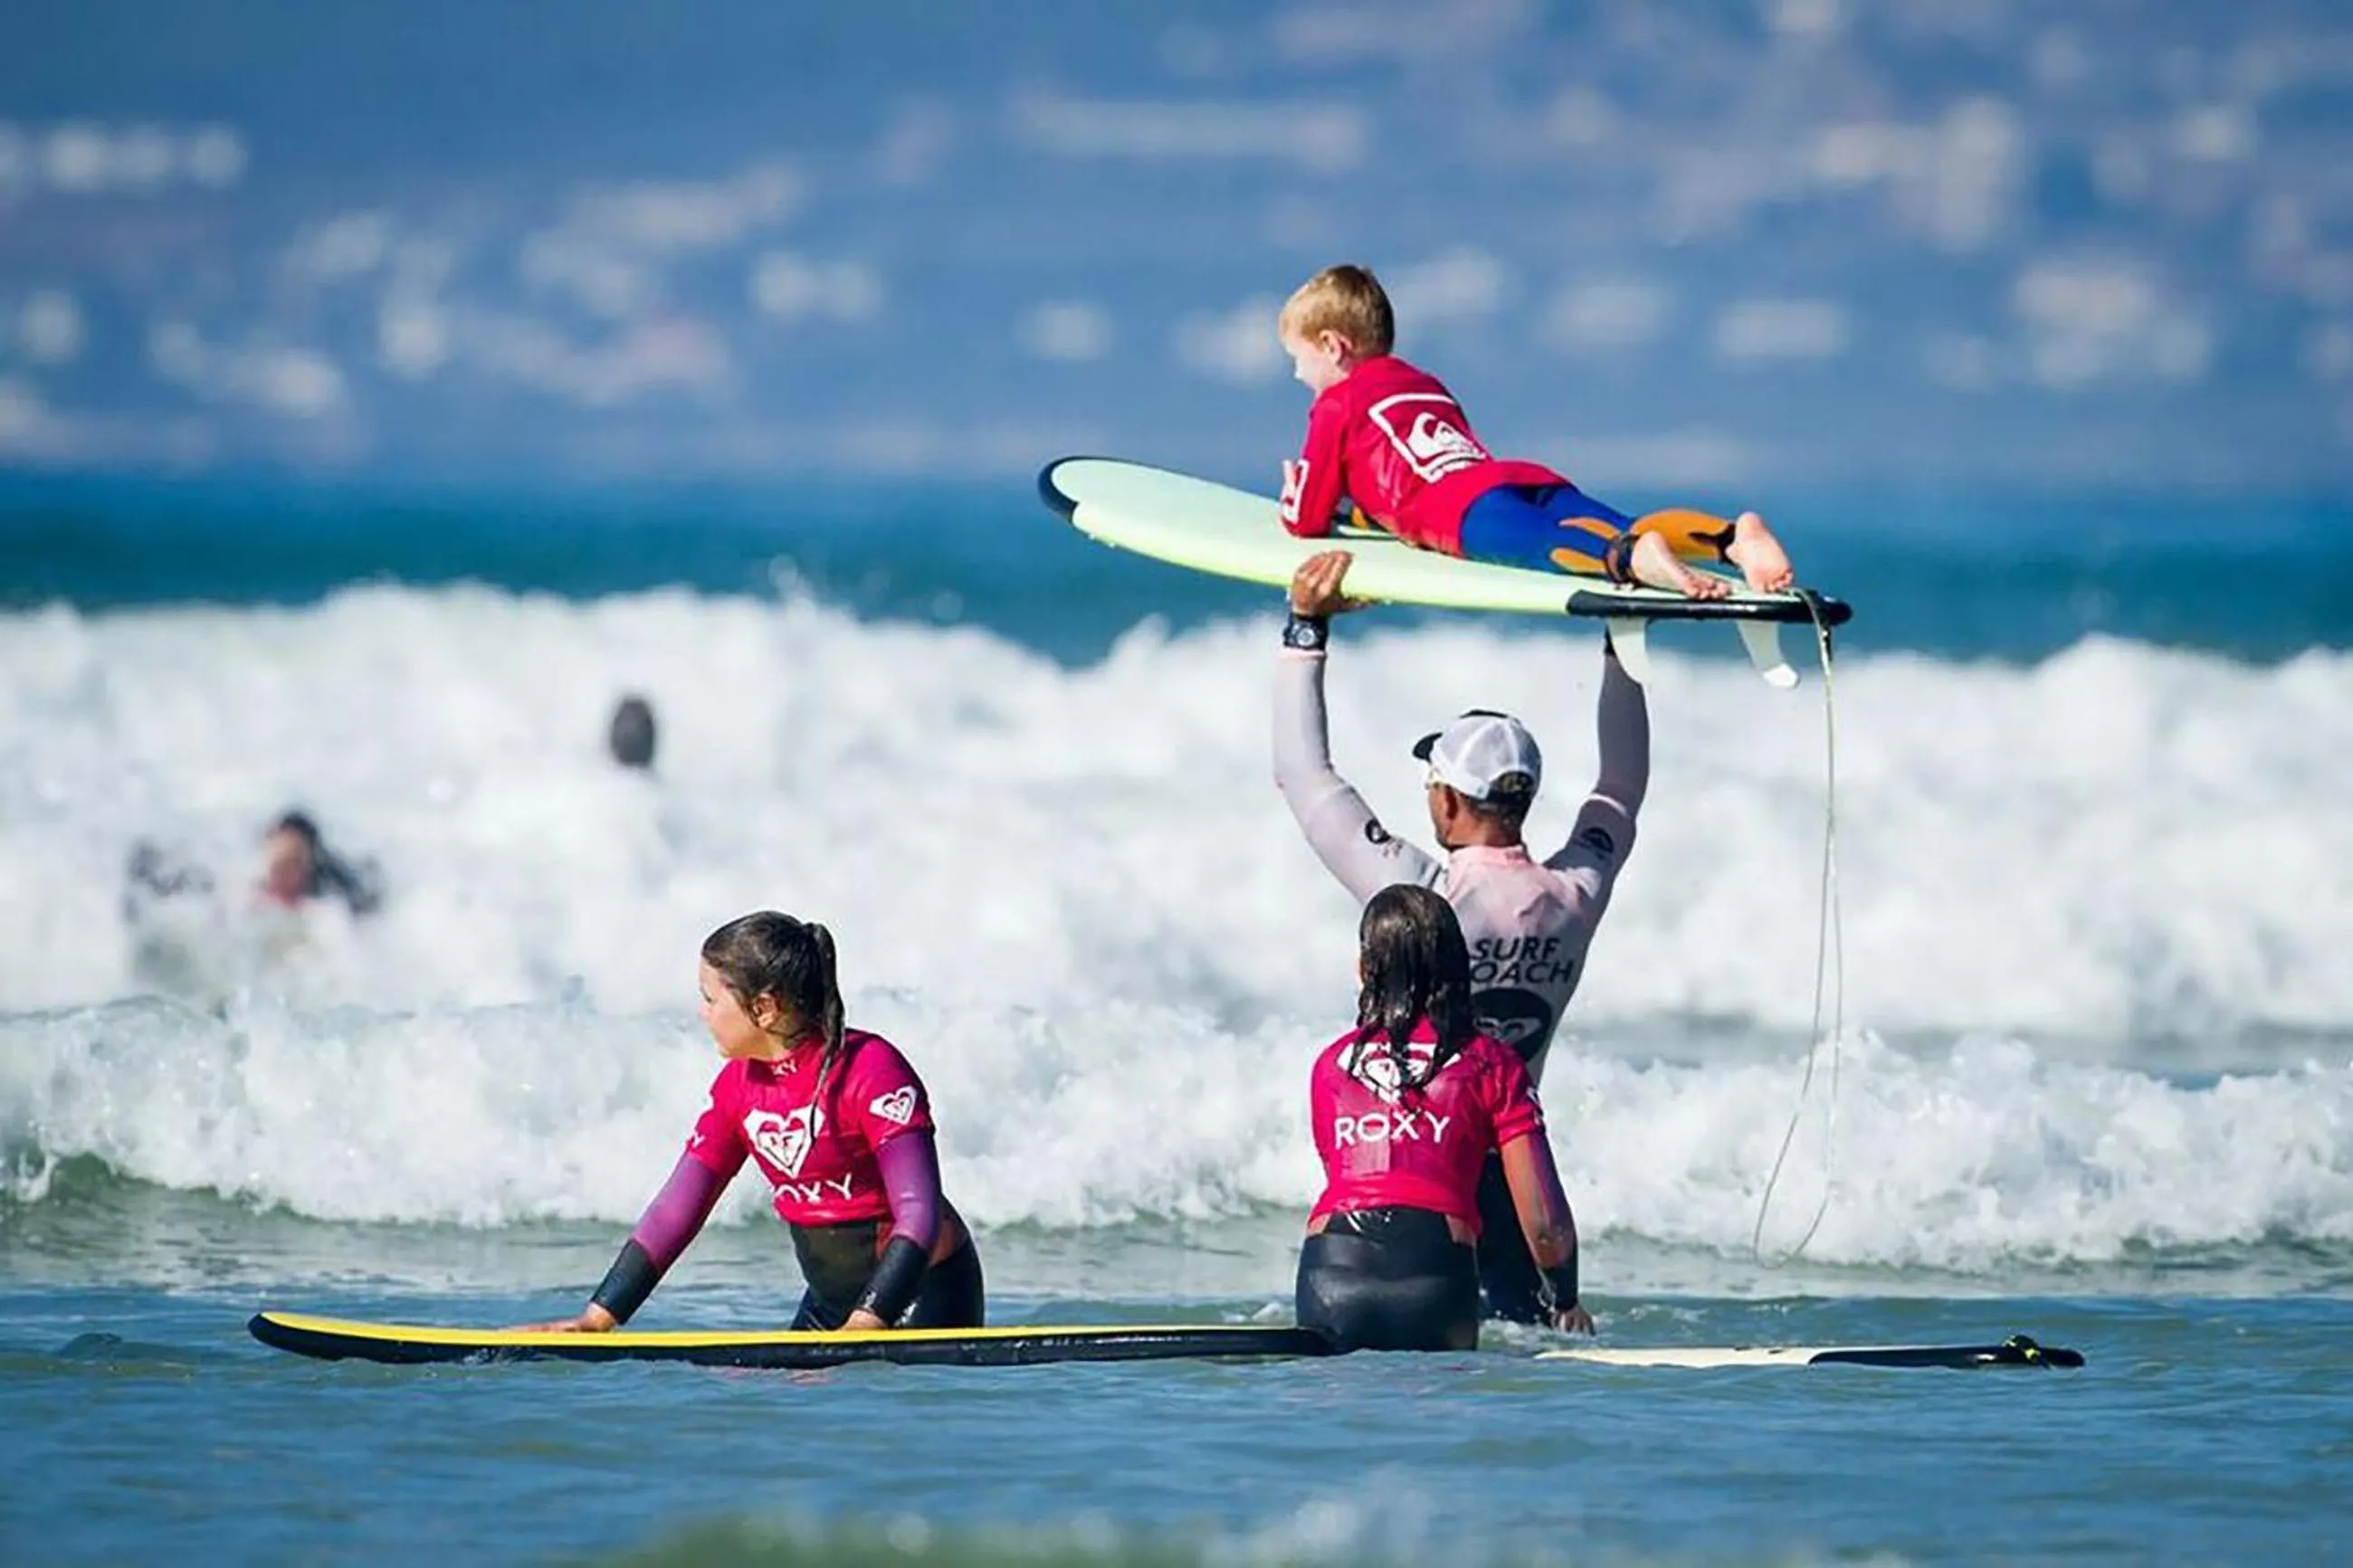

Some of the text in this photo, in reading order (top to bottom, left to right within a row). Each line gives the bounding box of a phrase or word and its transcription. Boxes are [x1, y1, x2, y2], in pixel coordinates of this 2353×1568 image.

[1470, 937, 1559, 961] SURF
[1471, 960, 1574, 984] OACH
[1335, 1113, 1450, 1149] ROXY
[775, 1174, 852, 1203] OXY
